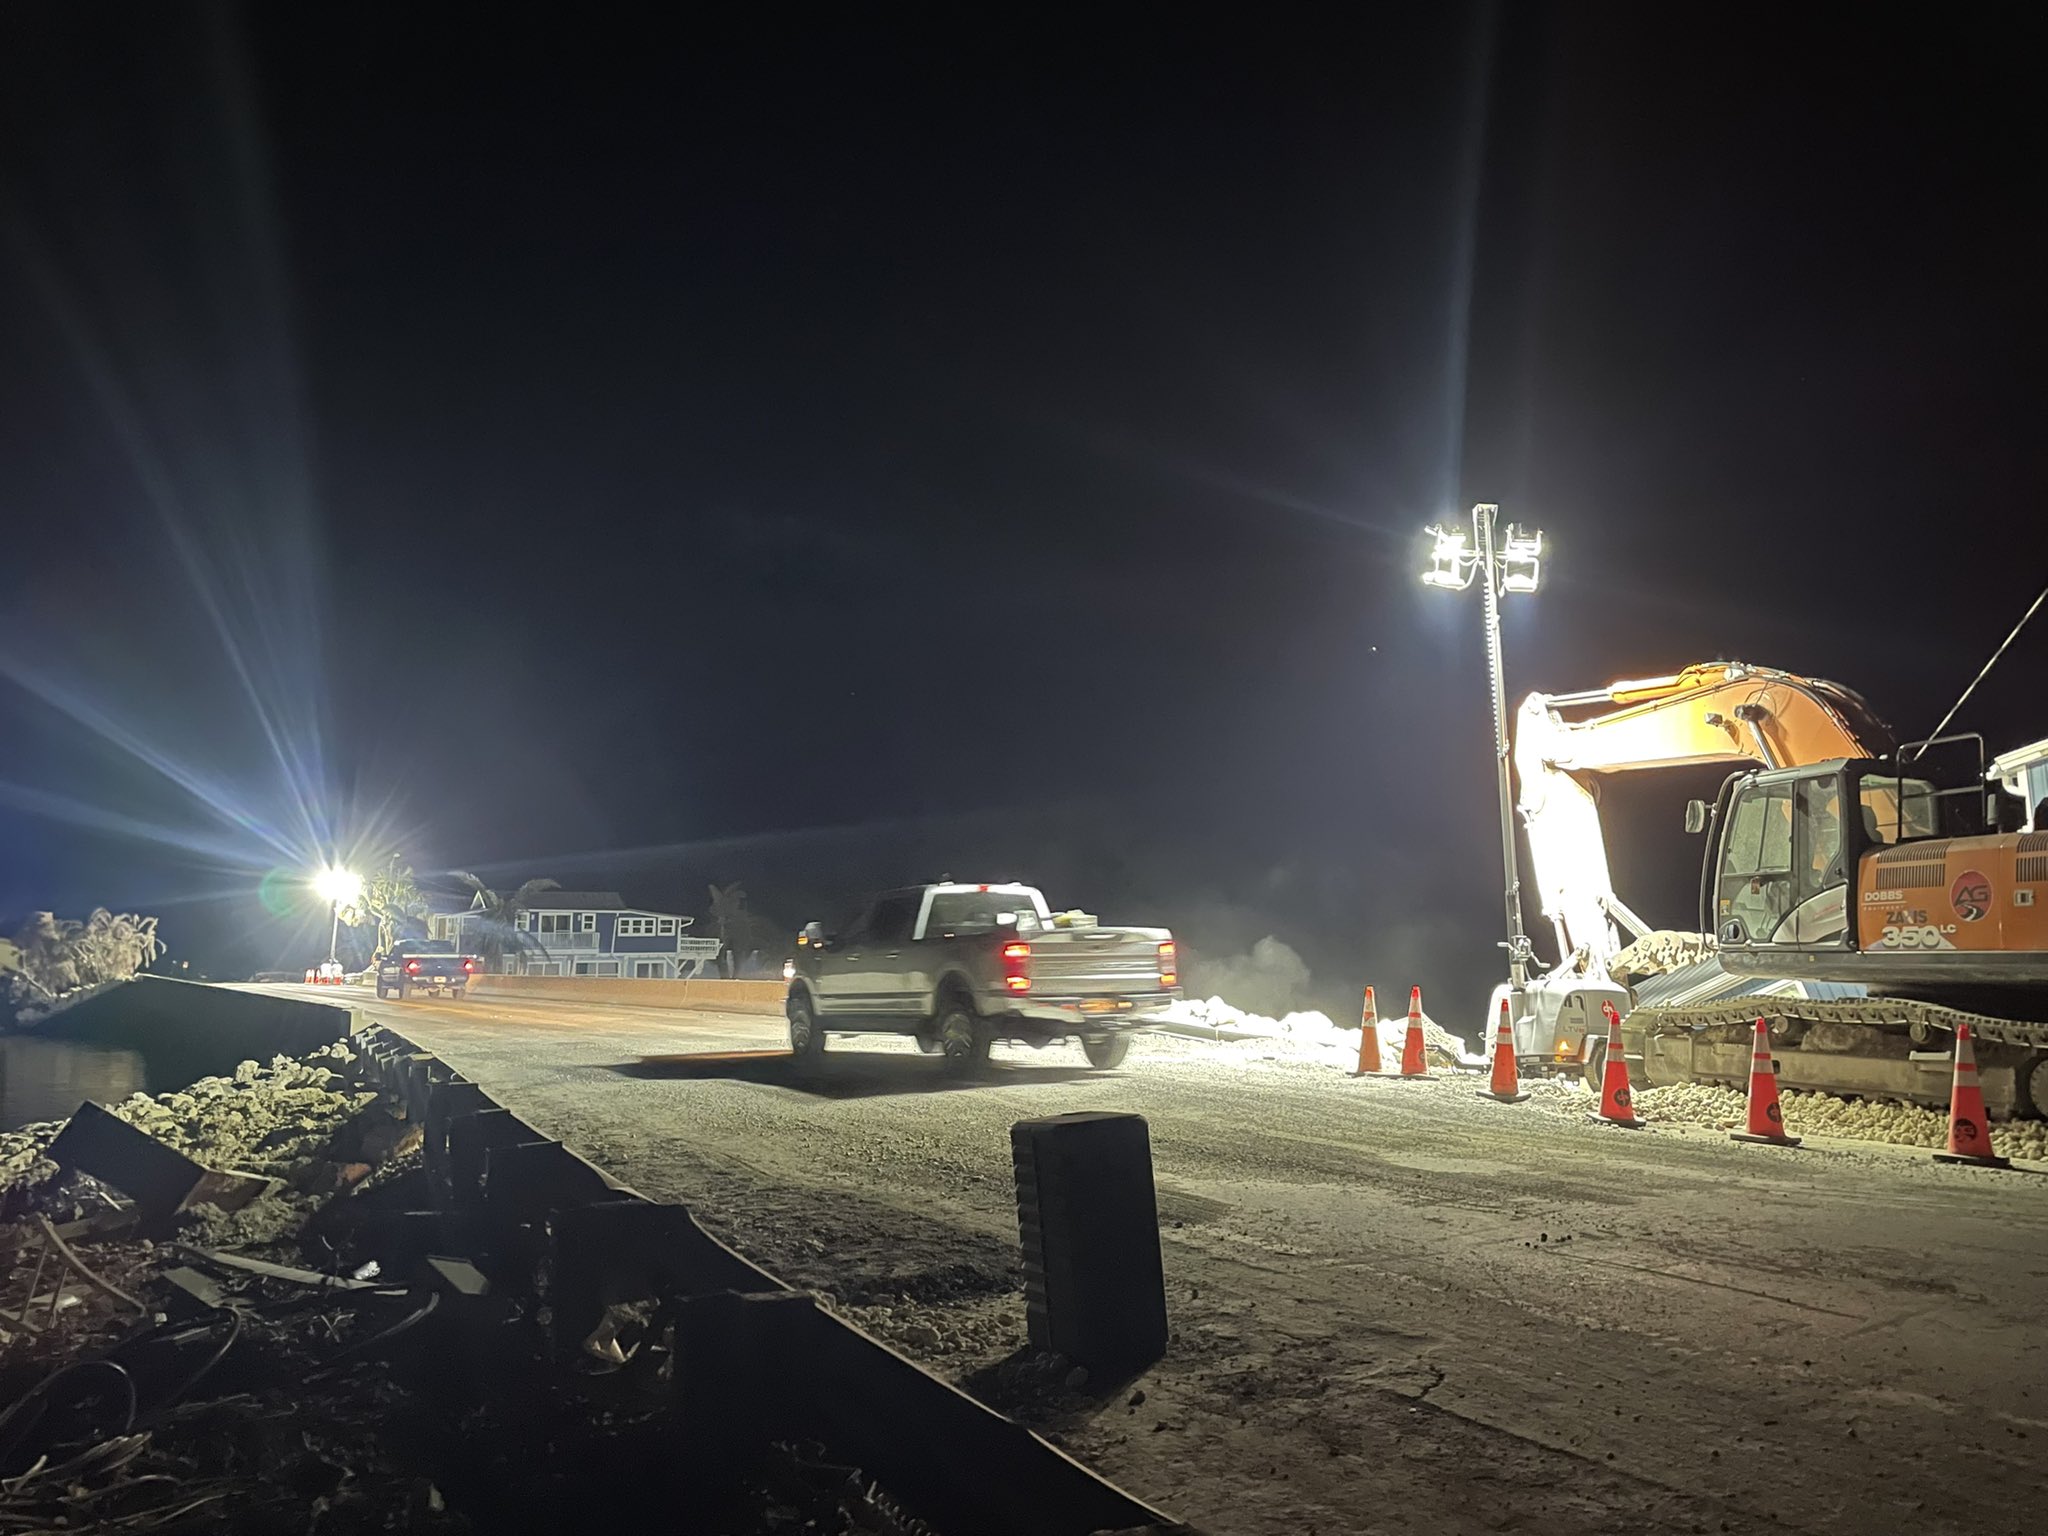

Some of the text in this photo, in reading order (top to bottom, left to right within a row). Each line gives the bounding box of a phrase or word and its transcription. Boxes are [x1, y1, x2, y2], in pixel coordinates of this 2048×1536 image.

[1864, 890, 1903, 902] DOBBS
[1955, 886, 1988, 906] AG
[1886, 910, 1928, 924] ZAXIS
[1881, 924, 1956, 949] 350 LC
